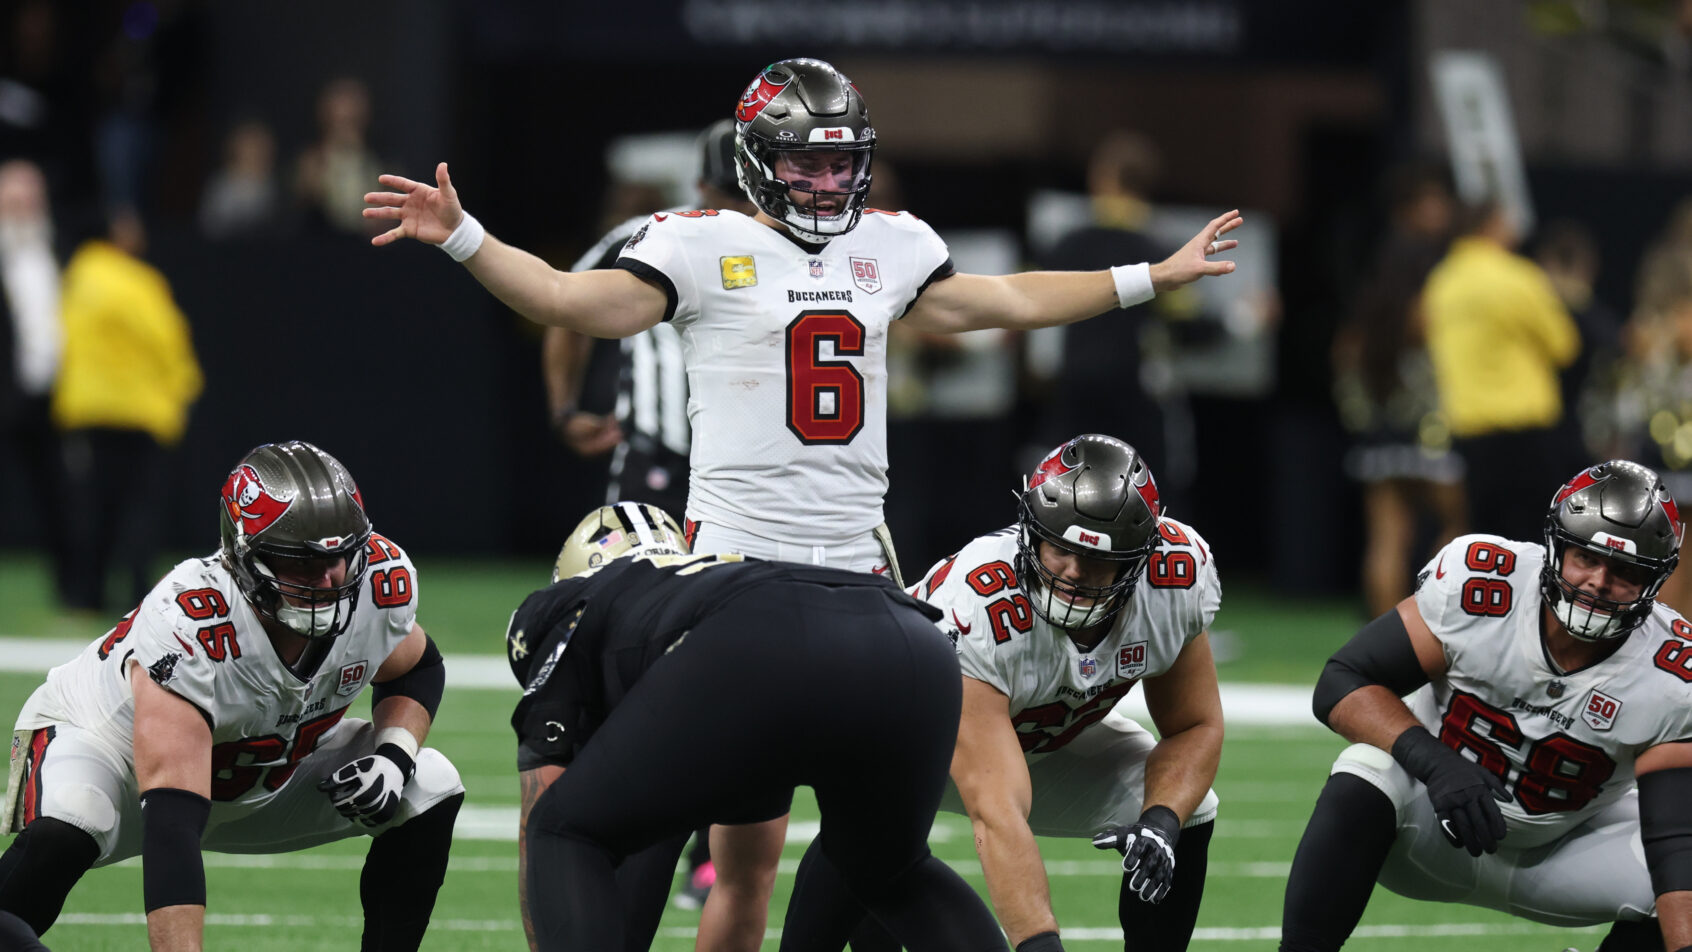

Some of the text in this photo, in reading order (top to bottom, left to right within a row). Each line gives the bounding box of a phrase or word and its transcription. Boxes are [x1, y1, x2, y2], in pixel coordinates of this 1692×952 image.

[853, 260, 878, 280] 50
[787, 289, 853, 303] BUCCANEERS
[785, 309, 866, 446] 6
[965, 560, 1033, 645] 62
[1461, 541, 1517, 618] 68
[175, 586, 242, 663] 65
[341, 664, 365, 686] 50
[1119, 645, 1145, 667] 50
[1587, 693, 1617, 718] 50
[1438, 689, 1617, 816] 68
